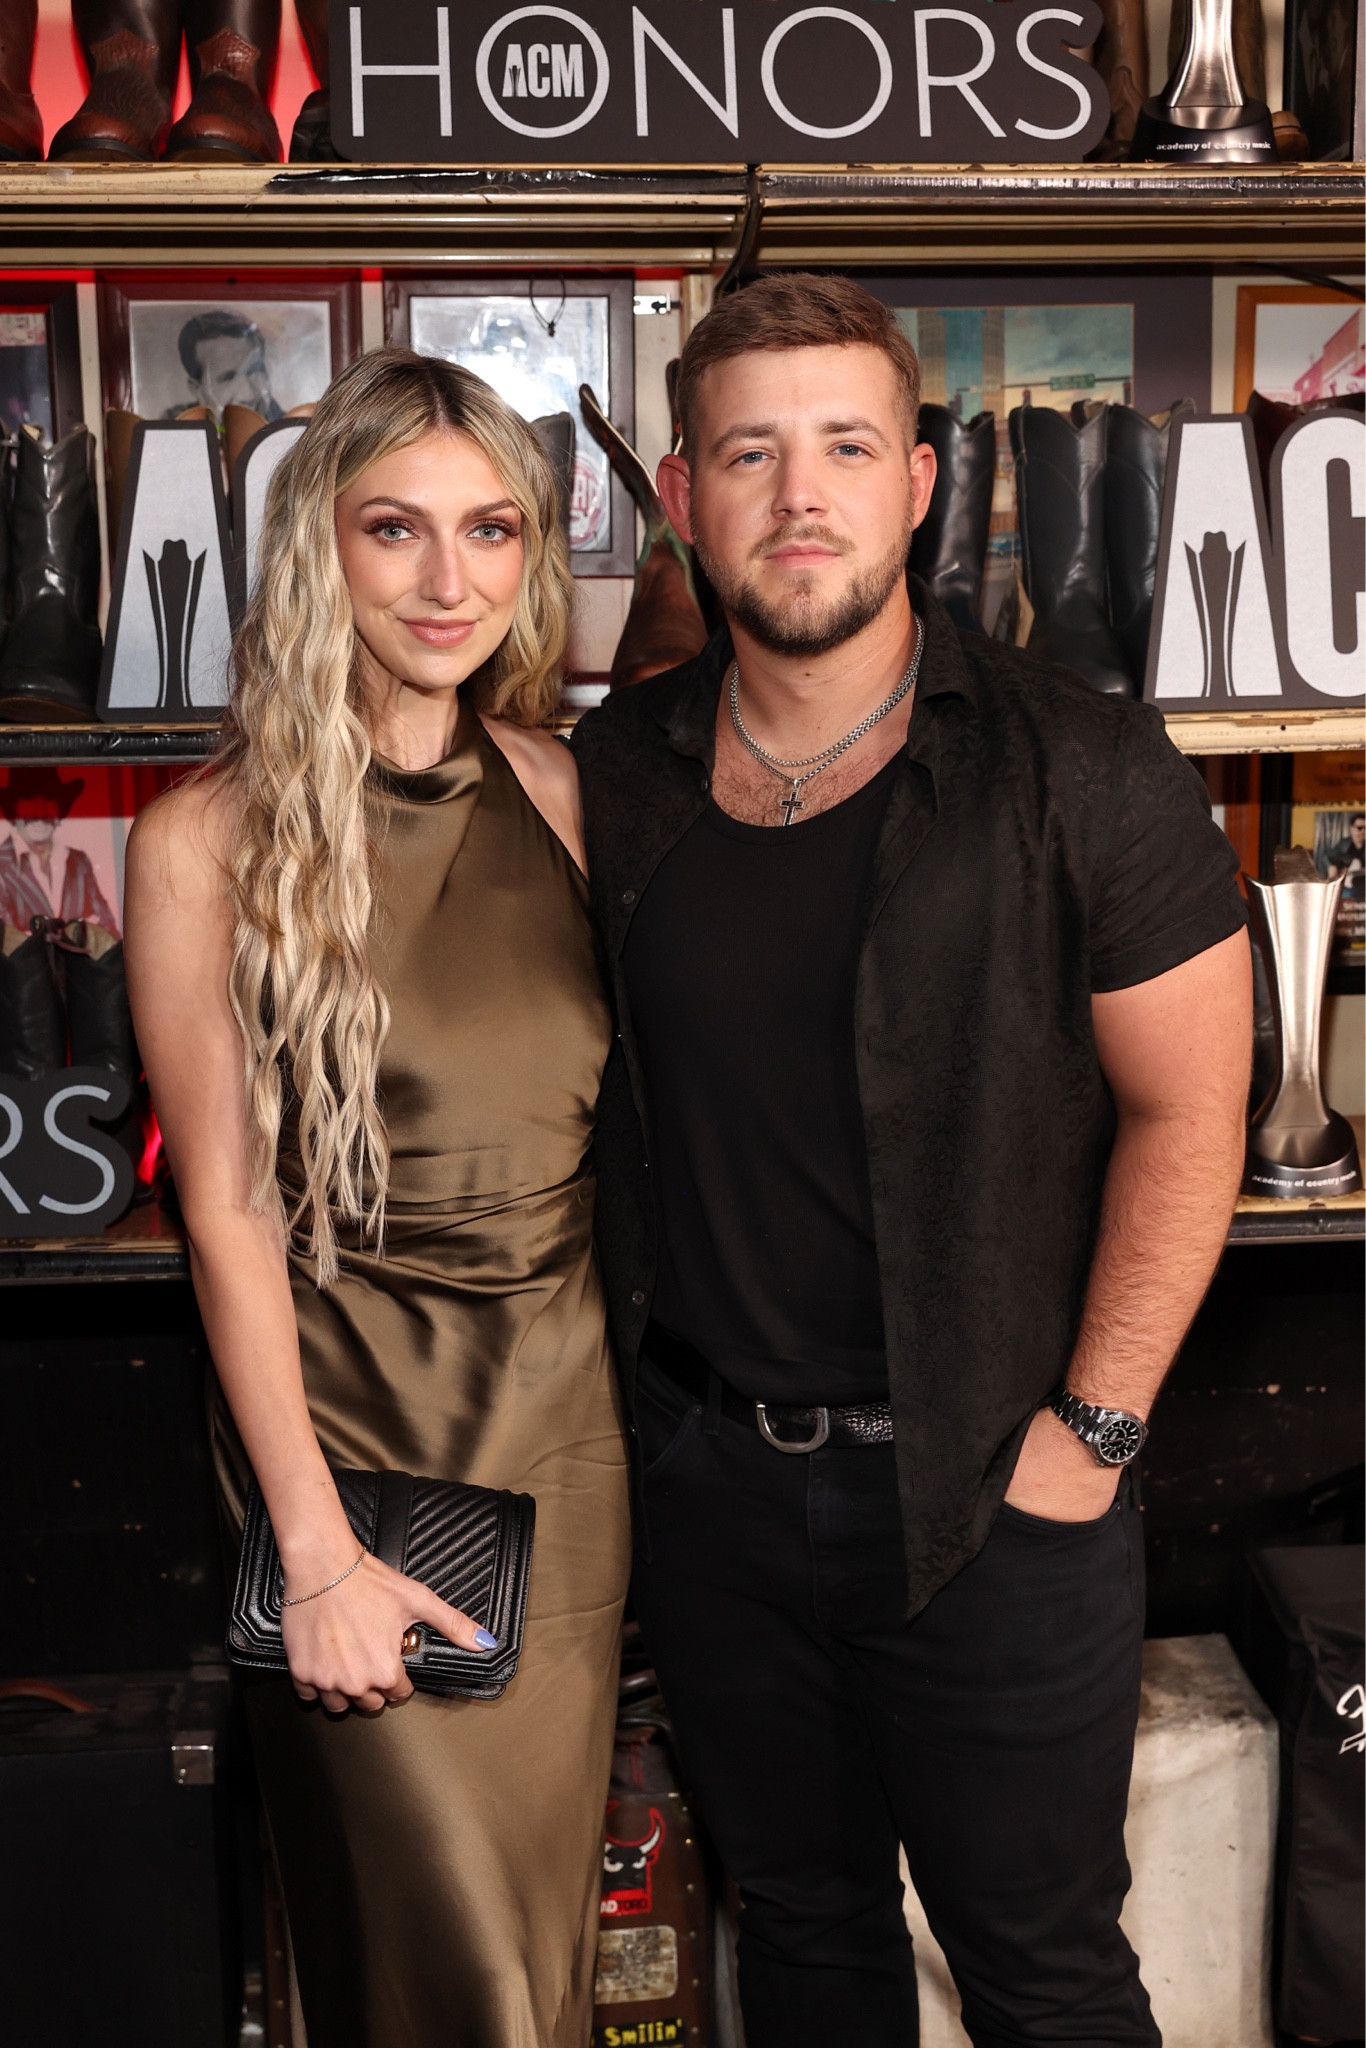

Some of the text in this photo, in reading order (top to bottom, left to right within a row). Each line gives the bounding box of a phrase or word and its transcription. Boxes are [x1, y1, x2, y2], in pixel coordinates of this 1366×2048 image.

[349, 5, 1092, 139] HONORS
[502, 43, 585, 98] ACM
[1156, 142, 1199, 152] academy
[1201, 142, 1212, 150] of
[1251, 1175, 1293, 1188] academy
[1306, 1176, 1340, 1188] country
[604, 2018, 683, 2047] Smilin'
